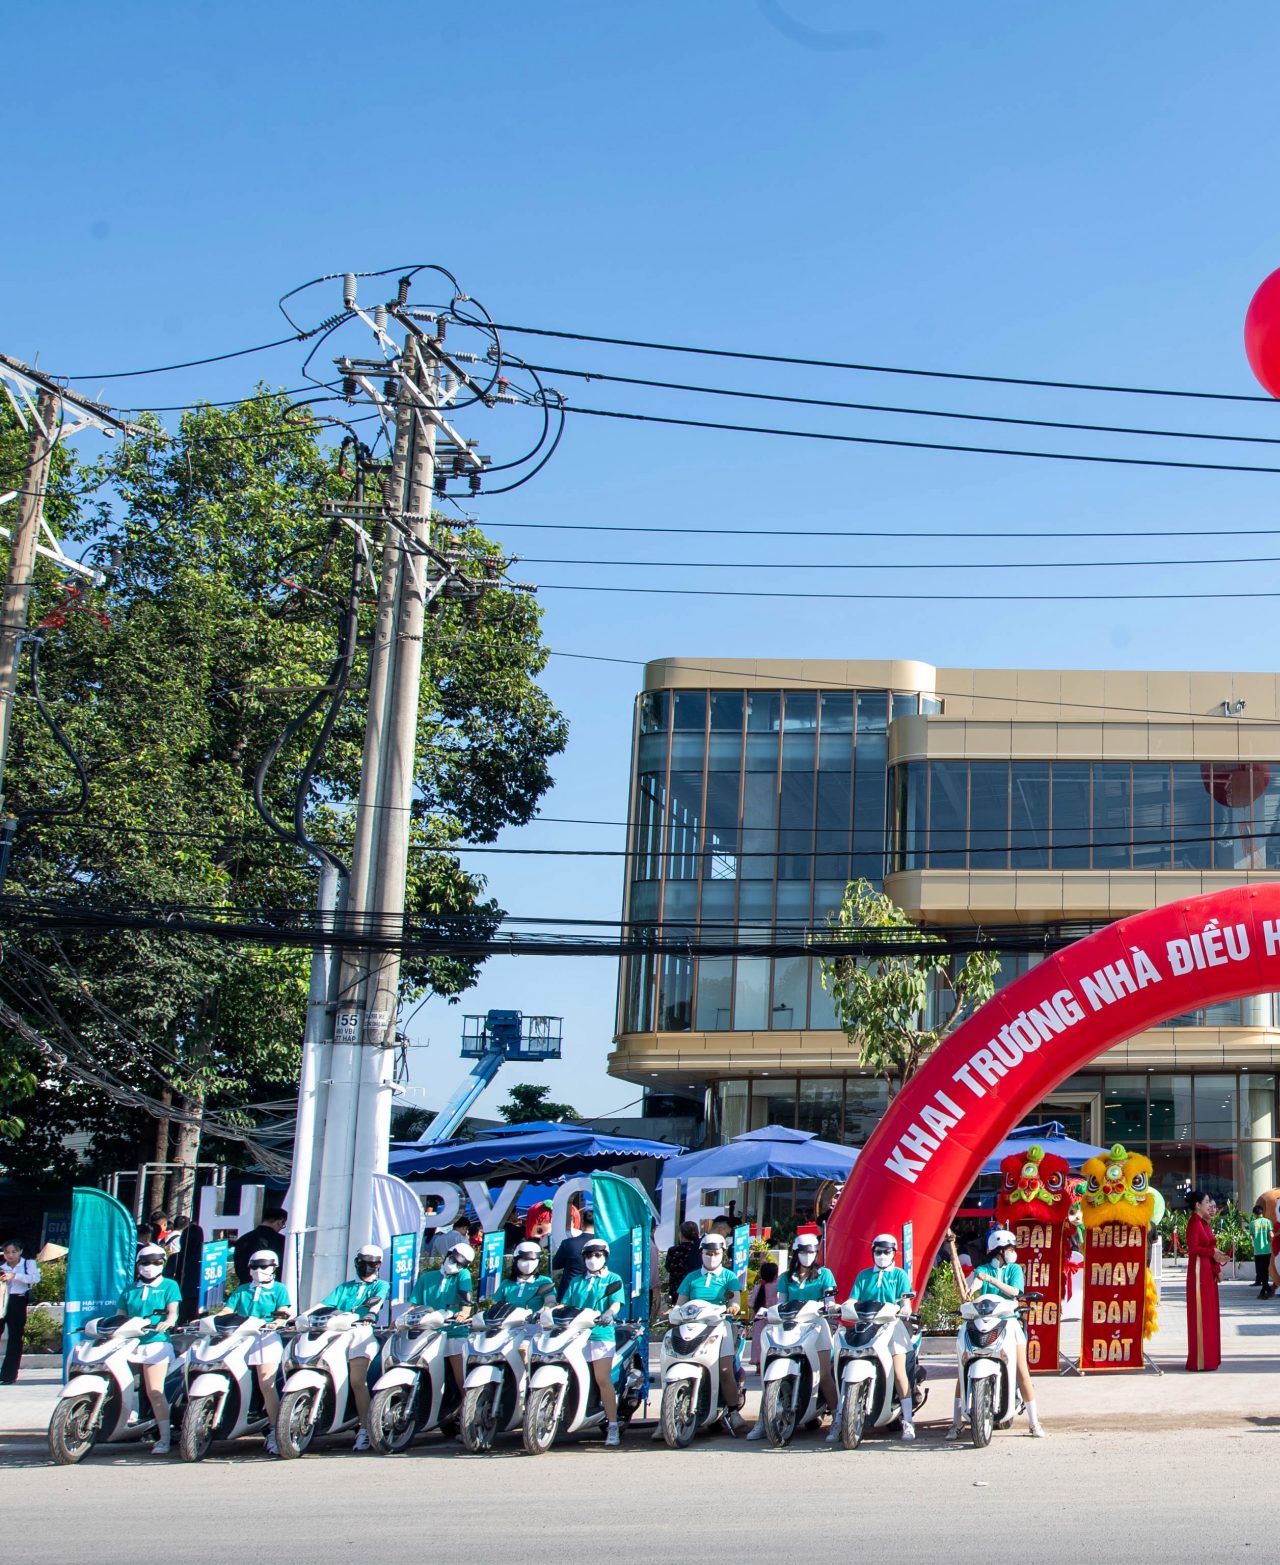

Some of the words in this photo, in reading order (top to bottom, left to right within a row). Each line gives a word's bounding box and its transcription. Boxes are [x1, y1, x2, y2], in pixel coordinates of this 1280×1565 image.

[885, 1089, 966, 1184] KHAI
[952, 988, 1087, 1098] TRƯƠNG
[1080, 943, 1162, 1012] NHÀ
[1166, 918, 1251, 977] ĐIỀU
[1091, 1225, 1142, 1249] MUA
[1090, 1262, 1140, 1286] MAY
[1092, 1293, 1137, 1324] BÁN
[1091, 1329, 1133, 1362] ĐẮT
